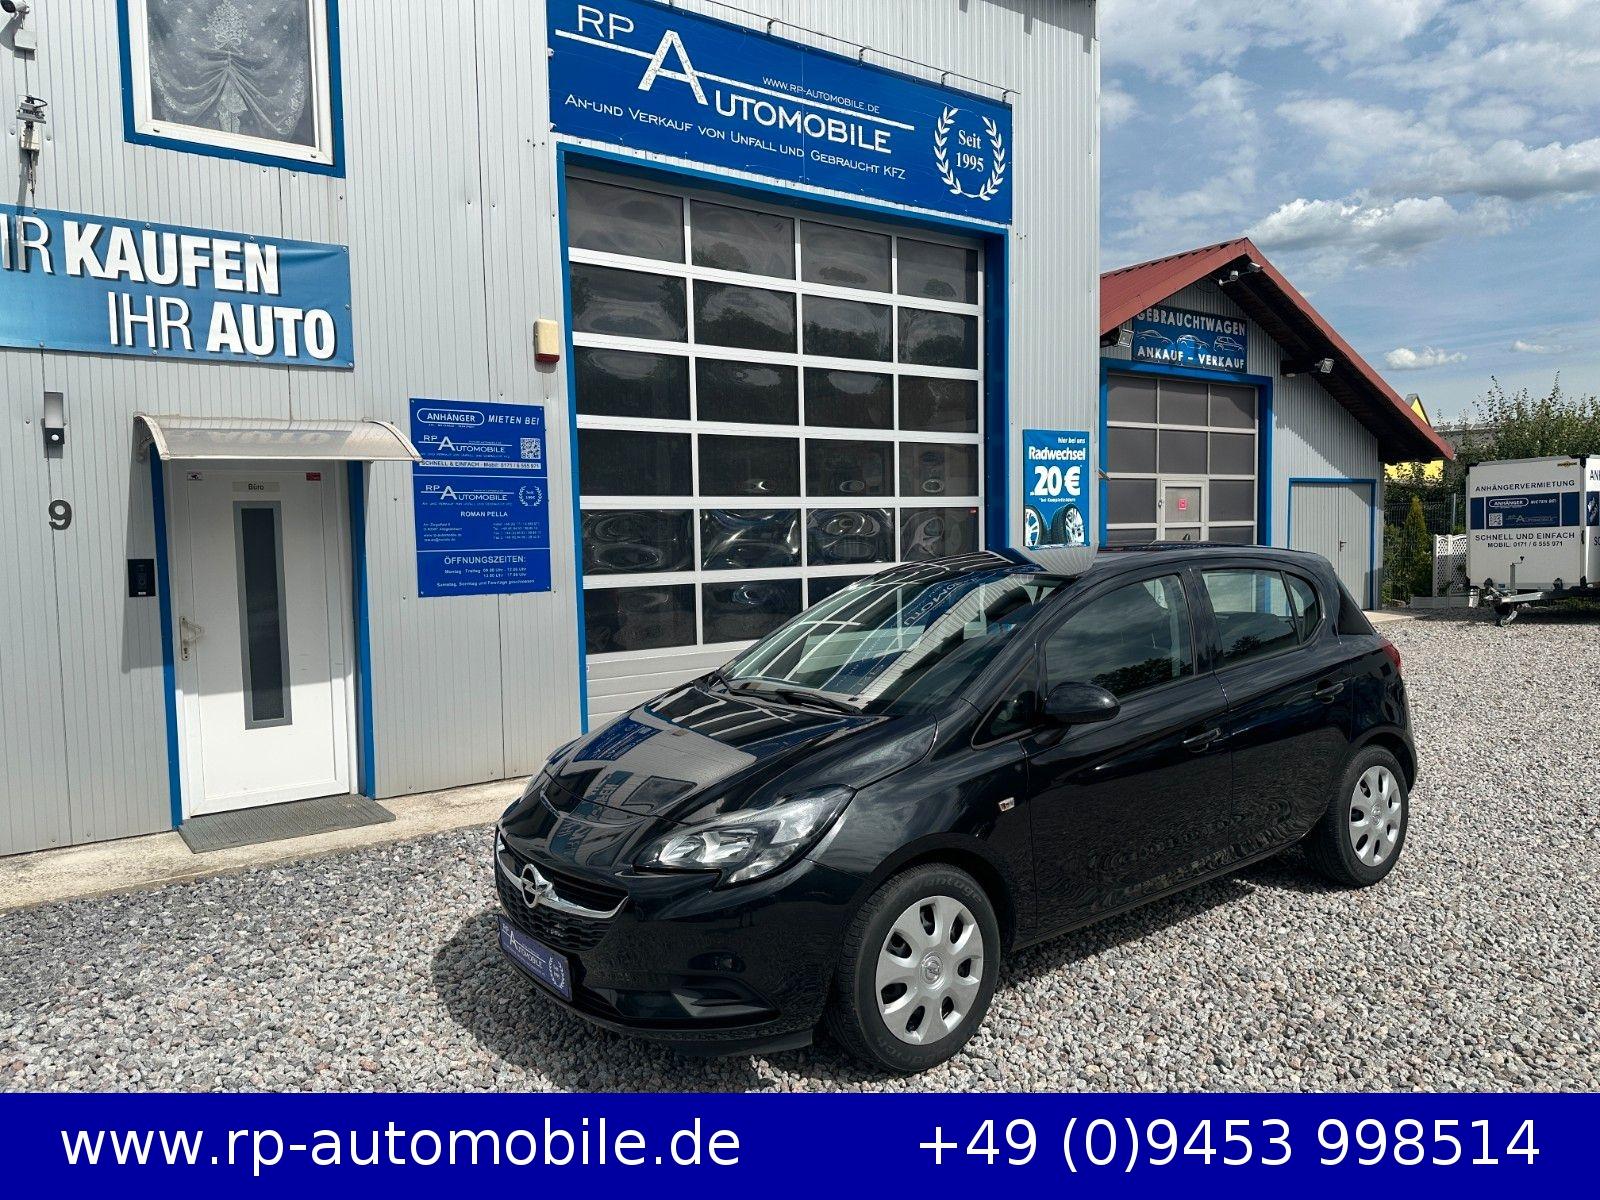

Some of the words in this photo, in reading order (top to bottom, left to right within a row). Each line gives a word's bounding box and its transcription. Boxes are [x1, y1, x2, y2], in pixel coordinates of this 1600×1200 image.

[577, 4, 634, 40] RP
[628, 107, 693, 132] VERKAUF
[698, 126, 725, 140] VON
[730, 131, 778, 152] UNFALL
[780, 143, 804, 158] UND
[811, 149, 879, 175] GEBRAUCHT
[883, 165, 906, 180] KFZ
[958, 129, 981, 150] Seit
[956, 152, 984, 173] 1995
[63, 220, 281, 296] KAUFEN
[107, 291, 194, 351] IHR
[206, 301, 336, 360] AUTO
[1137, 345, 1184, 362] ANKAUF
[1198, 353, 1245, 369] VERKAUF
[488, 414, 522, 424] MIETEN
[524, 416, 540, 425] BEI
[423, 434, 438, 442] RP
[1028, 446, 1086, 461] Radwechsel
[1034, 465, 1063, 497] 20
[440, 485, 508, 501] AUTOMOBILE
[48, 499, 73, 531] 9
[1475, 533, 1513, 541] SCHNELL
[1536, 532, 1575, 540] EINFACH
